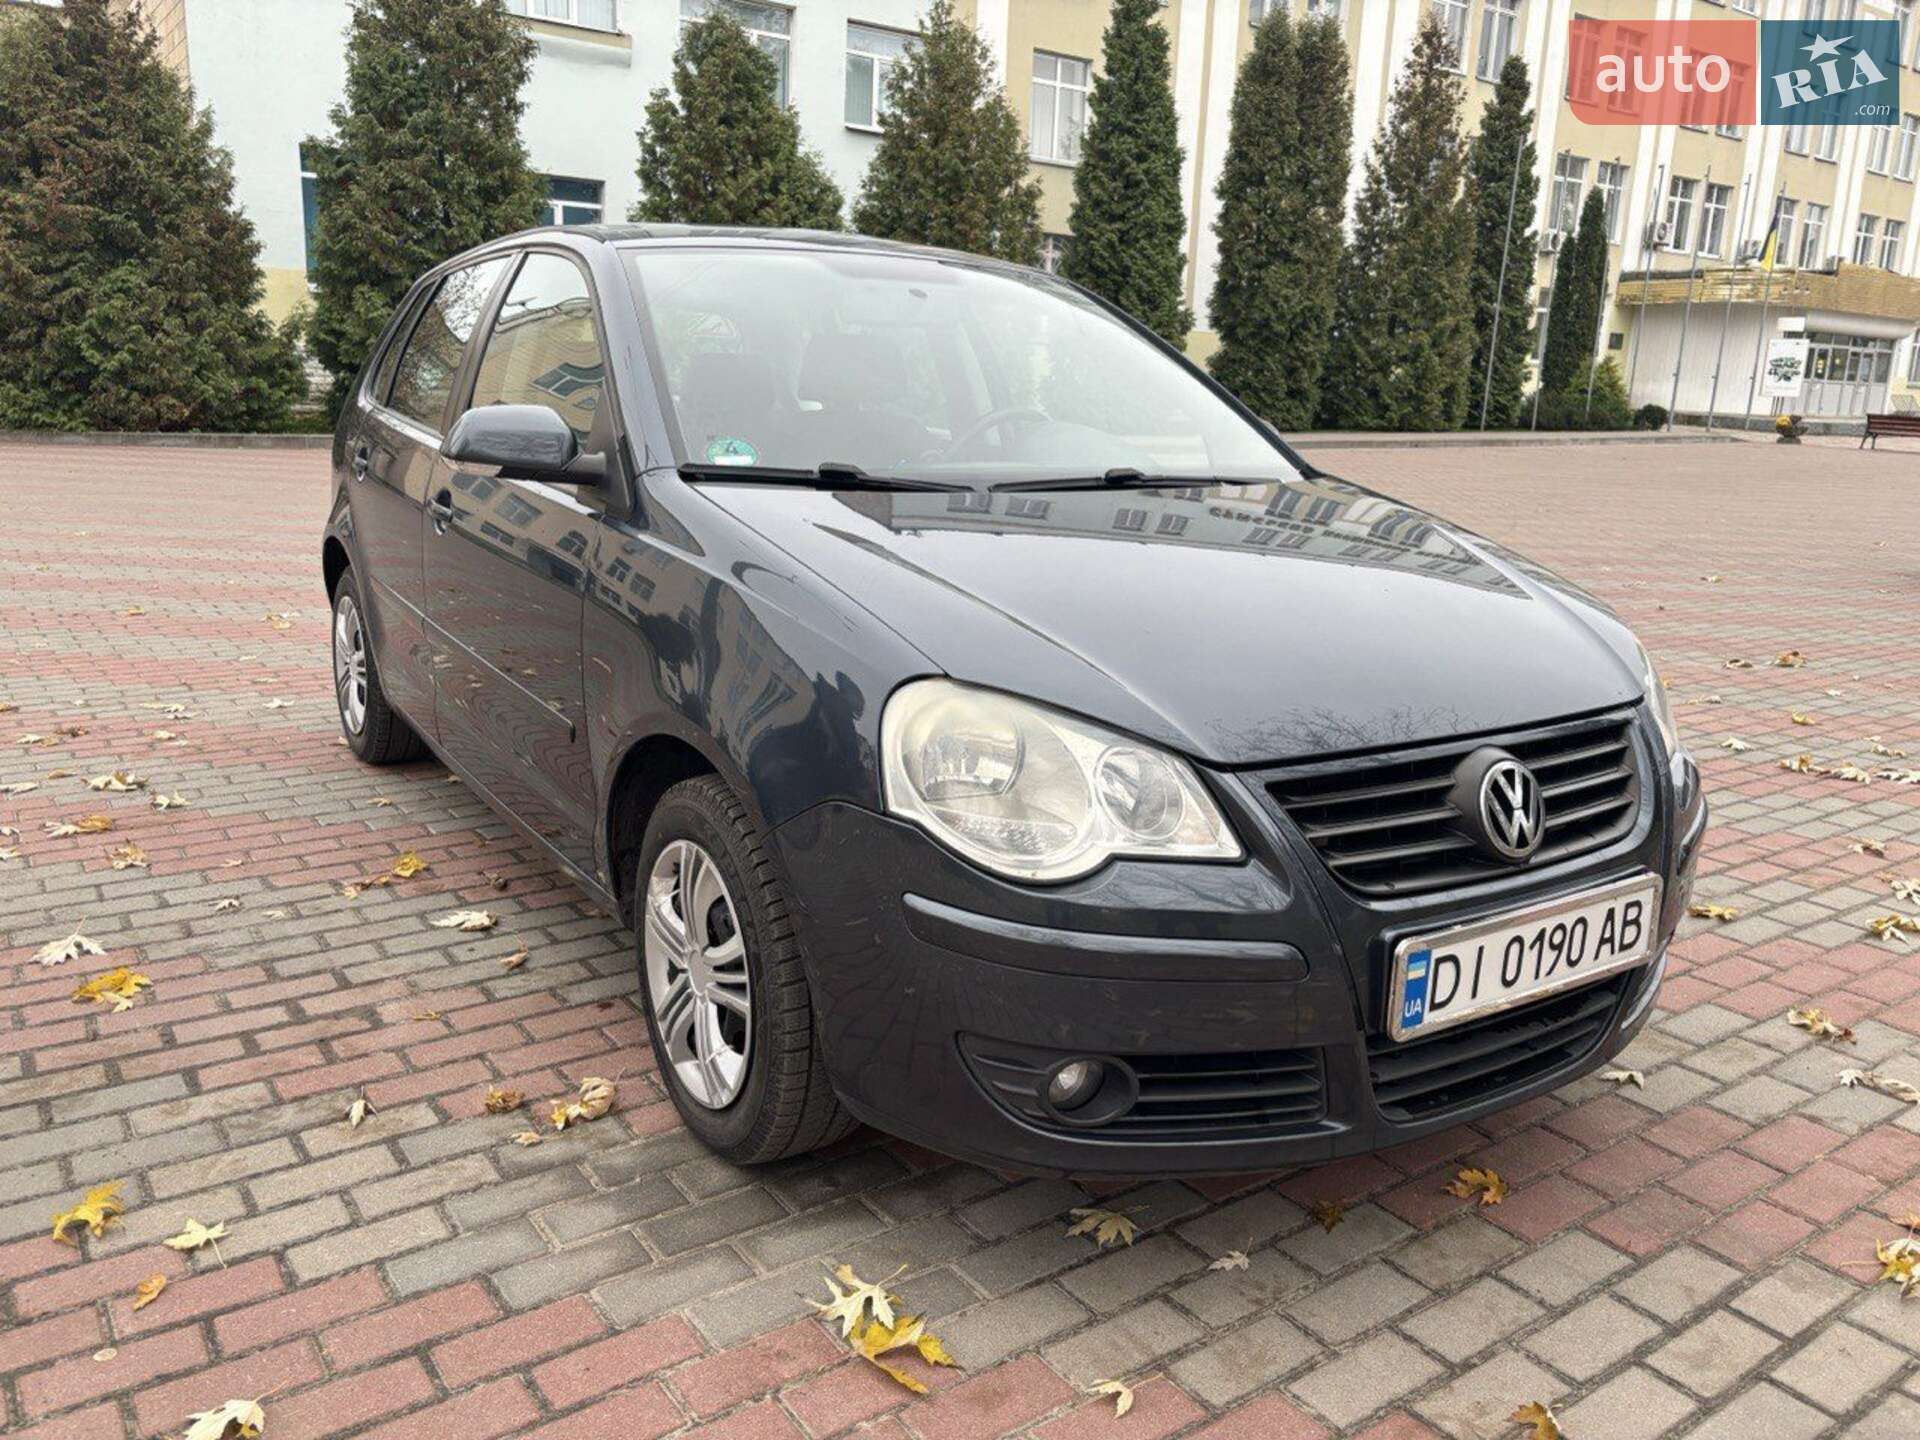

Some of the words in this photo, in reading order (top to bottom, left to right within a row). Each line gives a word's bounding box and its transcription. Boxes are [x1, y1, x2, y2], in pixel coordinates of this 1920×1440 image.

[1429, 945, 1484, 1012] DI
[1501, 917, 1588, 988] 0190
[1594, 900, 1642, 961] AB
[1405, 998, 1422, 1018] UA
